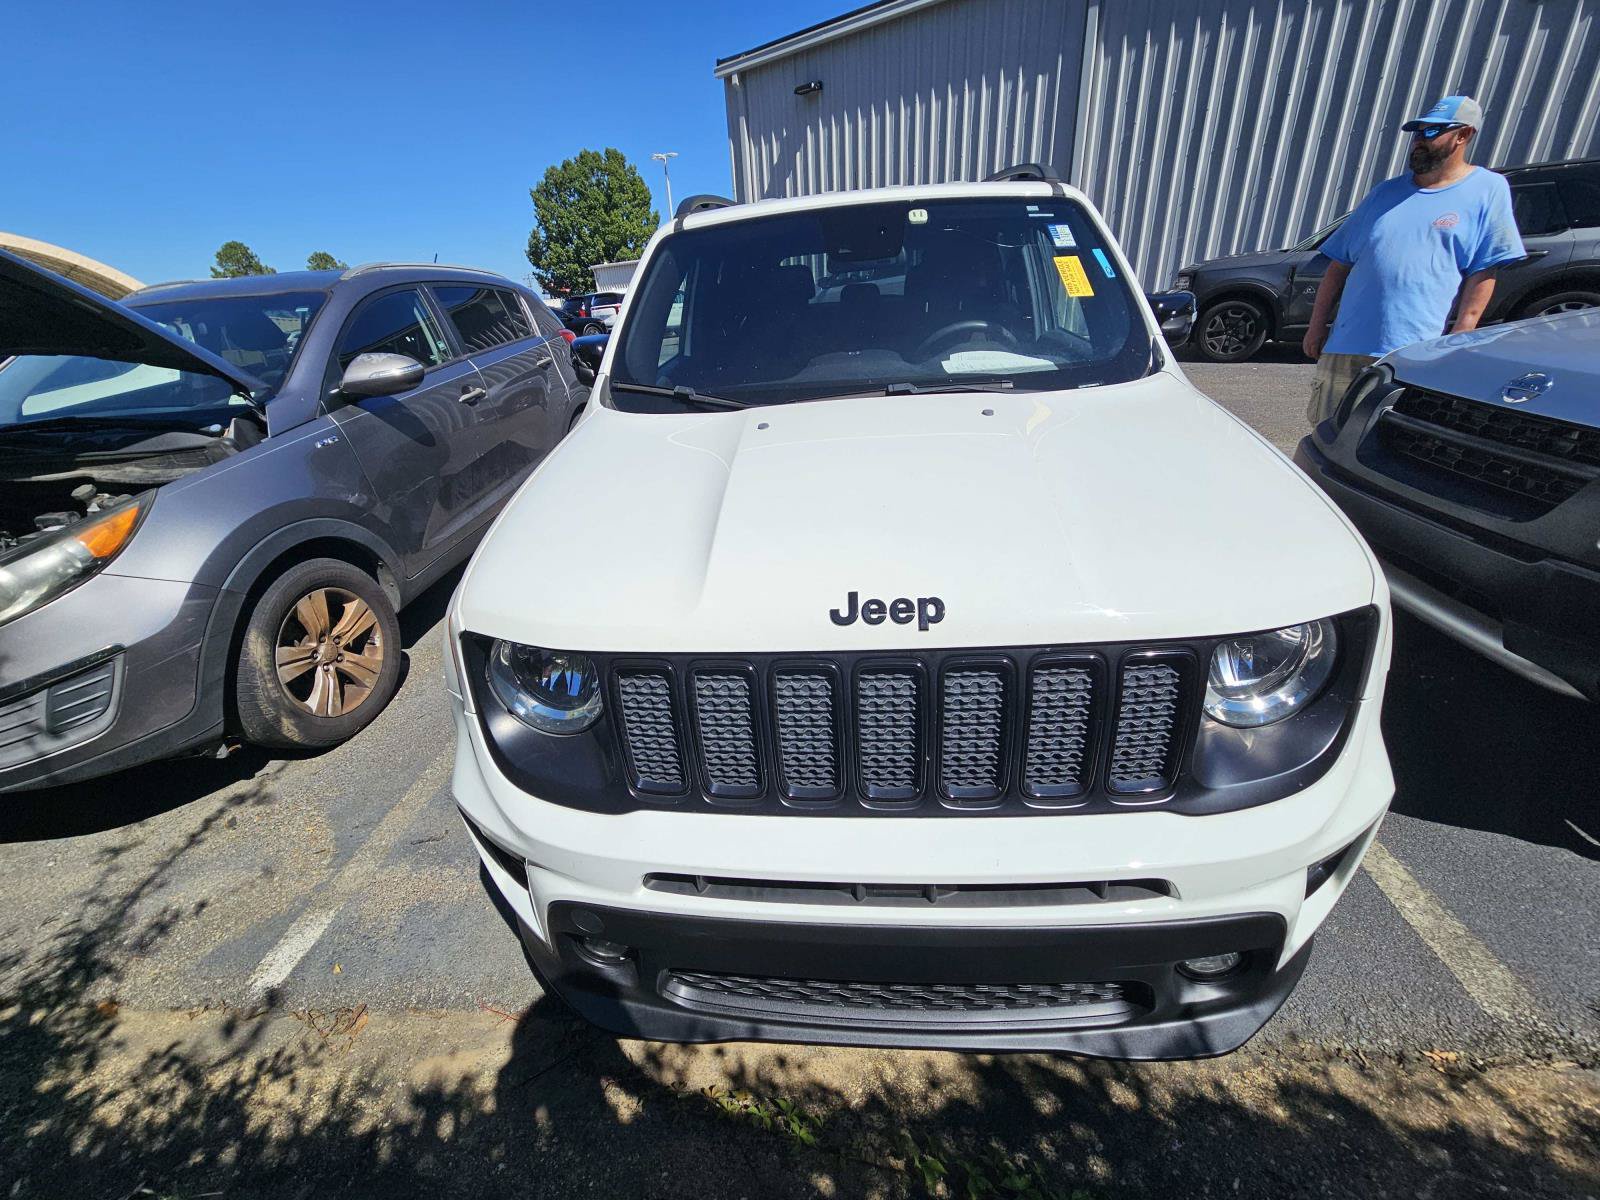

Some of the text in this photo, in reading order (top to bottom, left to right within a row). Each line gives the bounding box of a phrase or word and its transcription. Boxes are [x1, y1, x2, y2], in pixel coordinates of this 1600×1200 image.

[1056, 260, 1075, 294] THIS VEHICLE
[829, 591, 945, 631] Jeep
